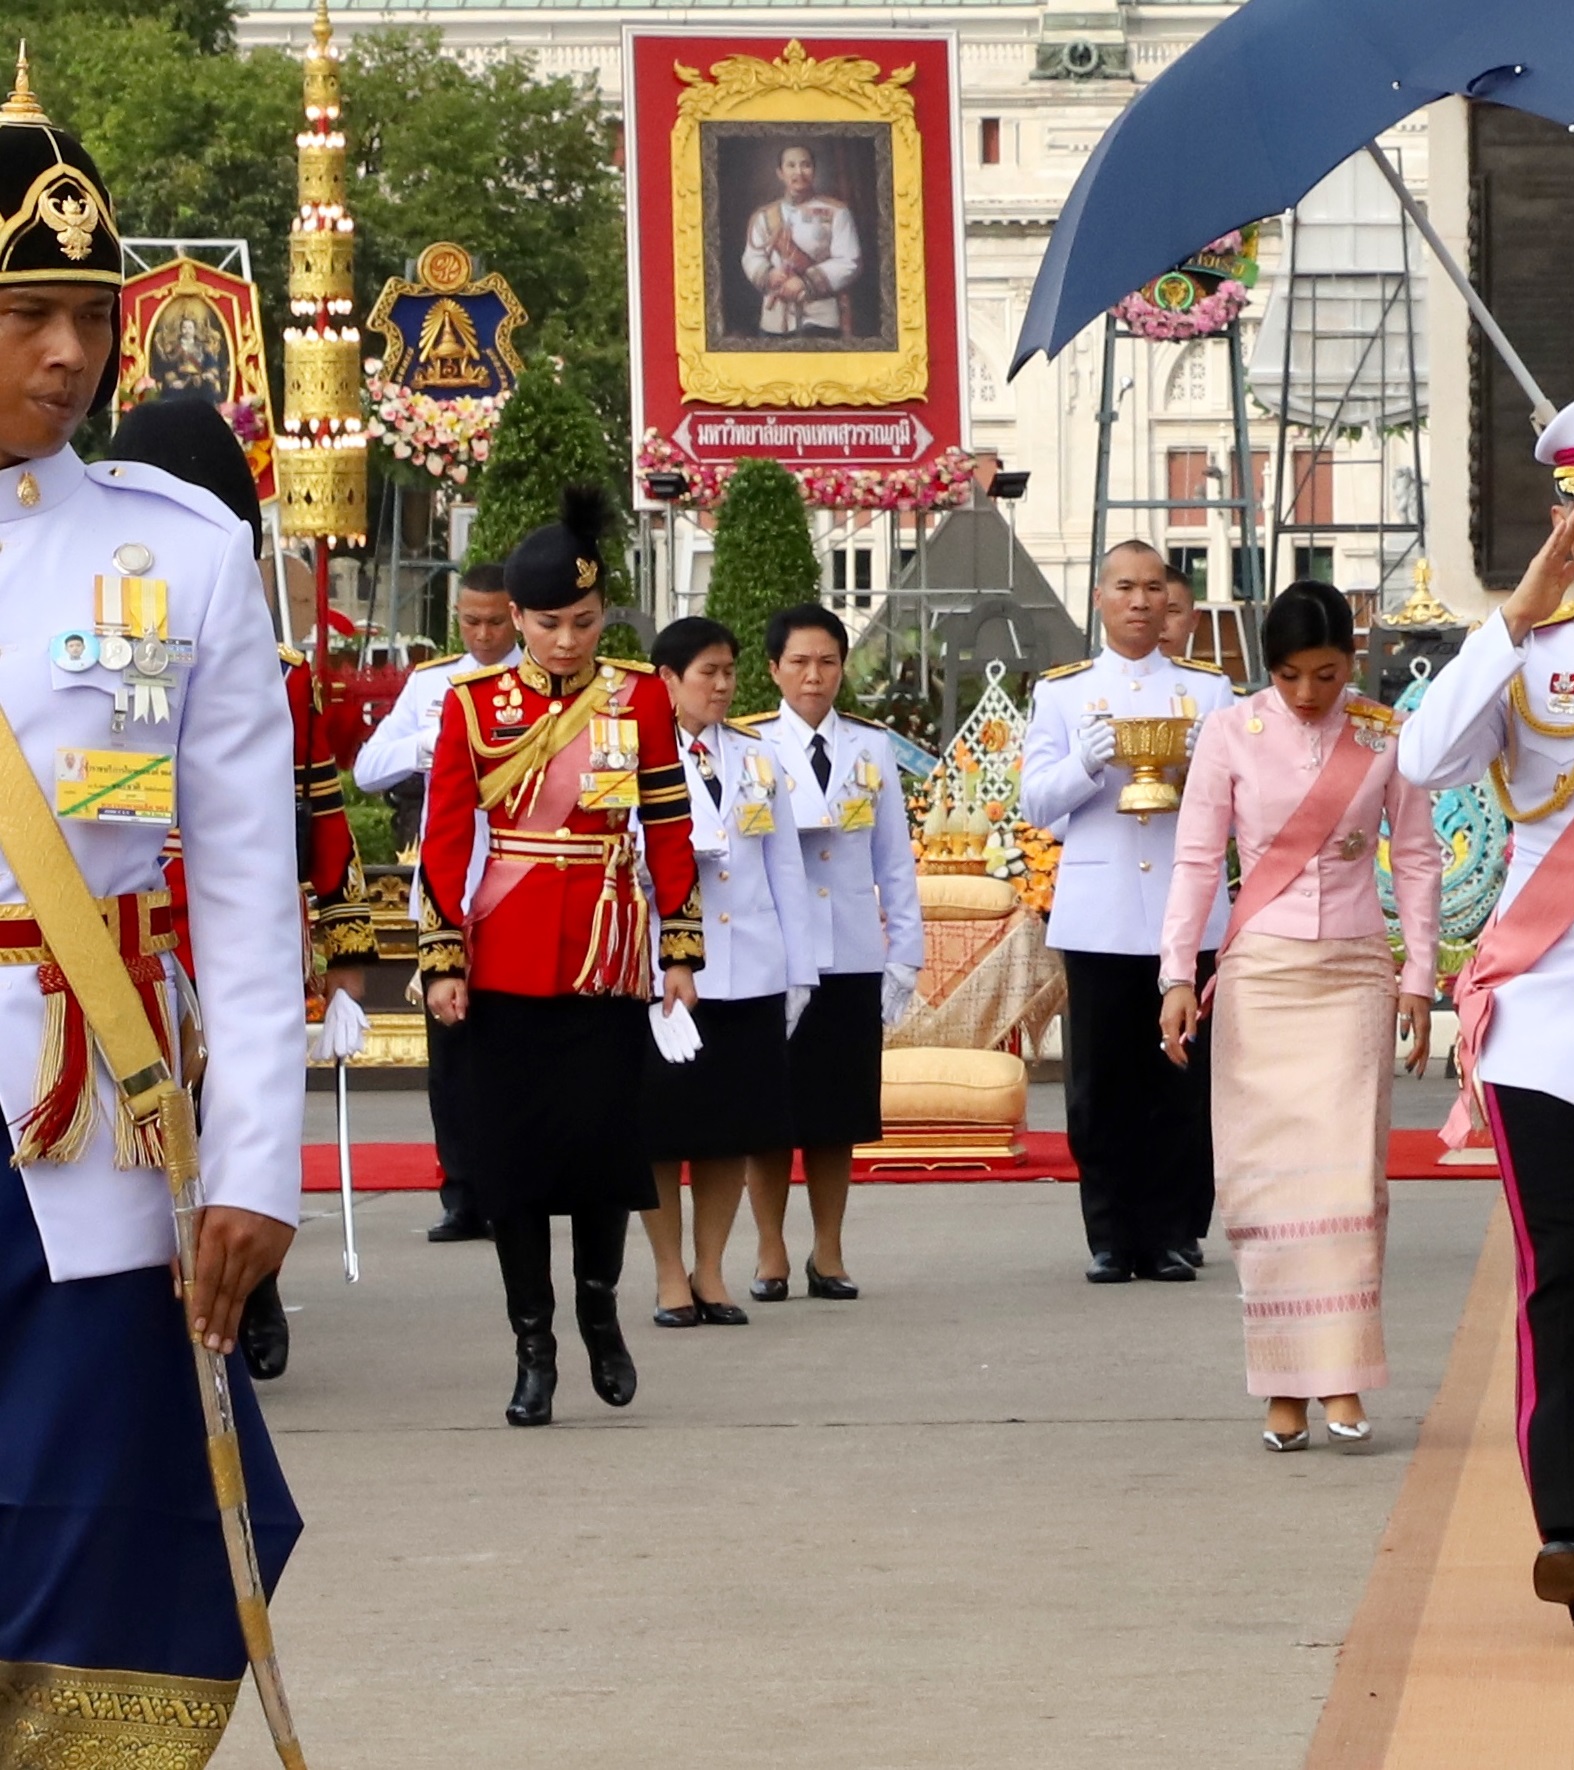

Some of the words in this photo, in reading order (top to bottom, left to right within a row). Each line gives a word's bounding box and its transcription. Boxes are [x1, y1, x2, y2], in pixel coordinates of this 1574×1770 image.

[697, 416, 910, 456] มหาวิทยาลัยกรุงเทพสุวรรณภูมิ
